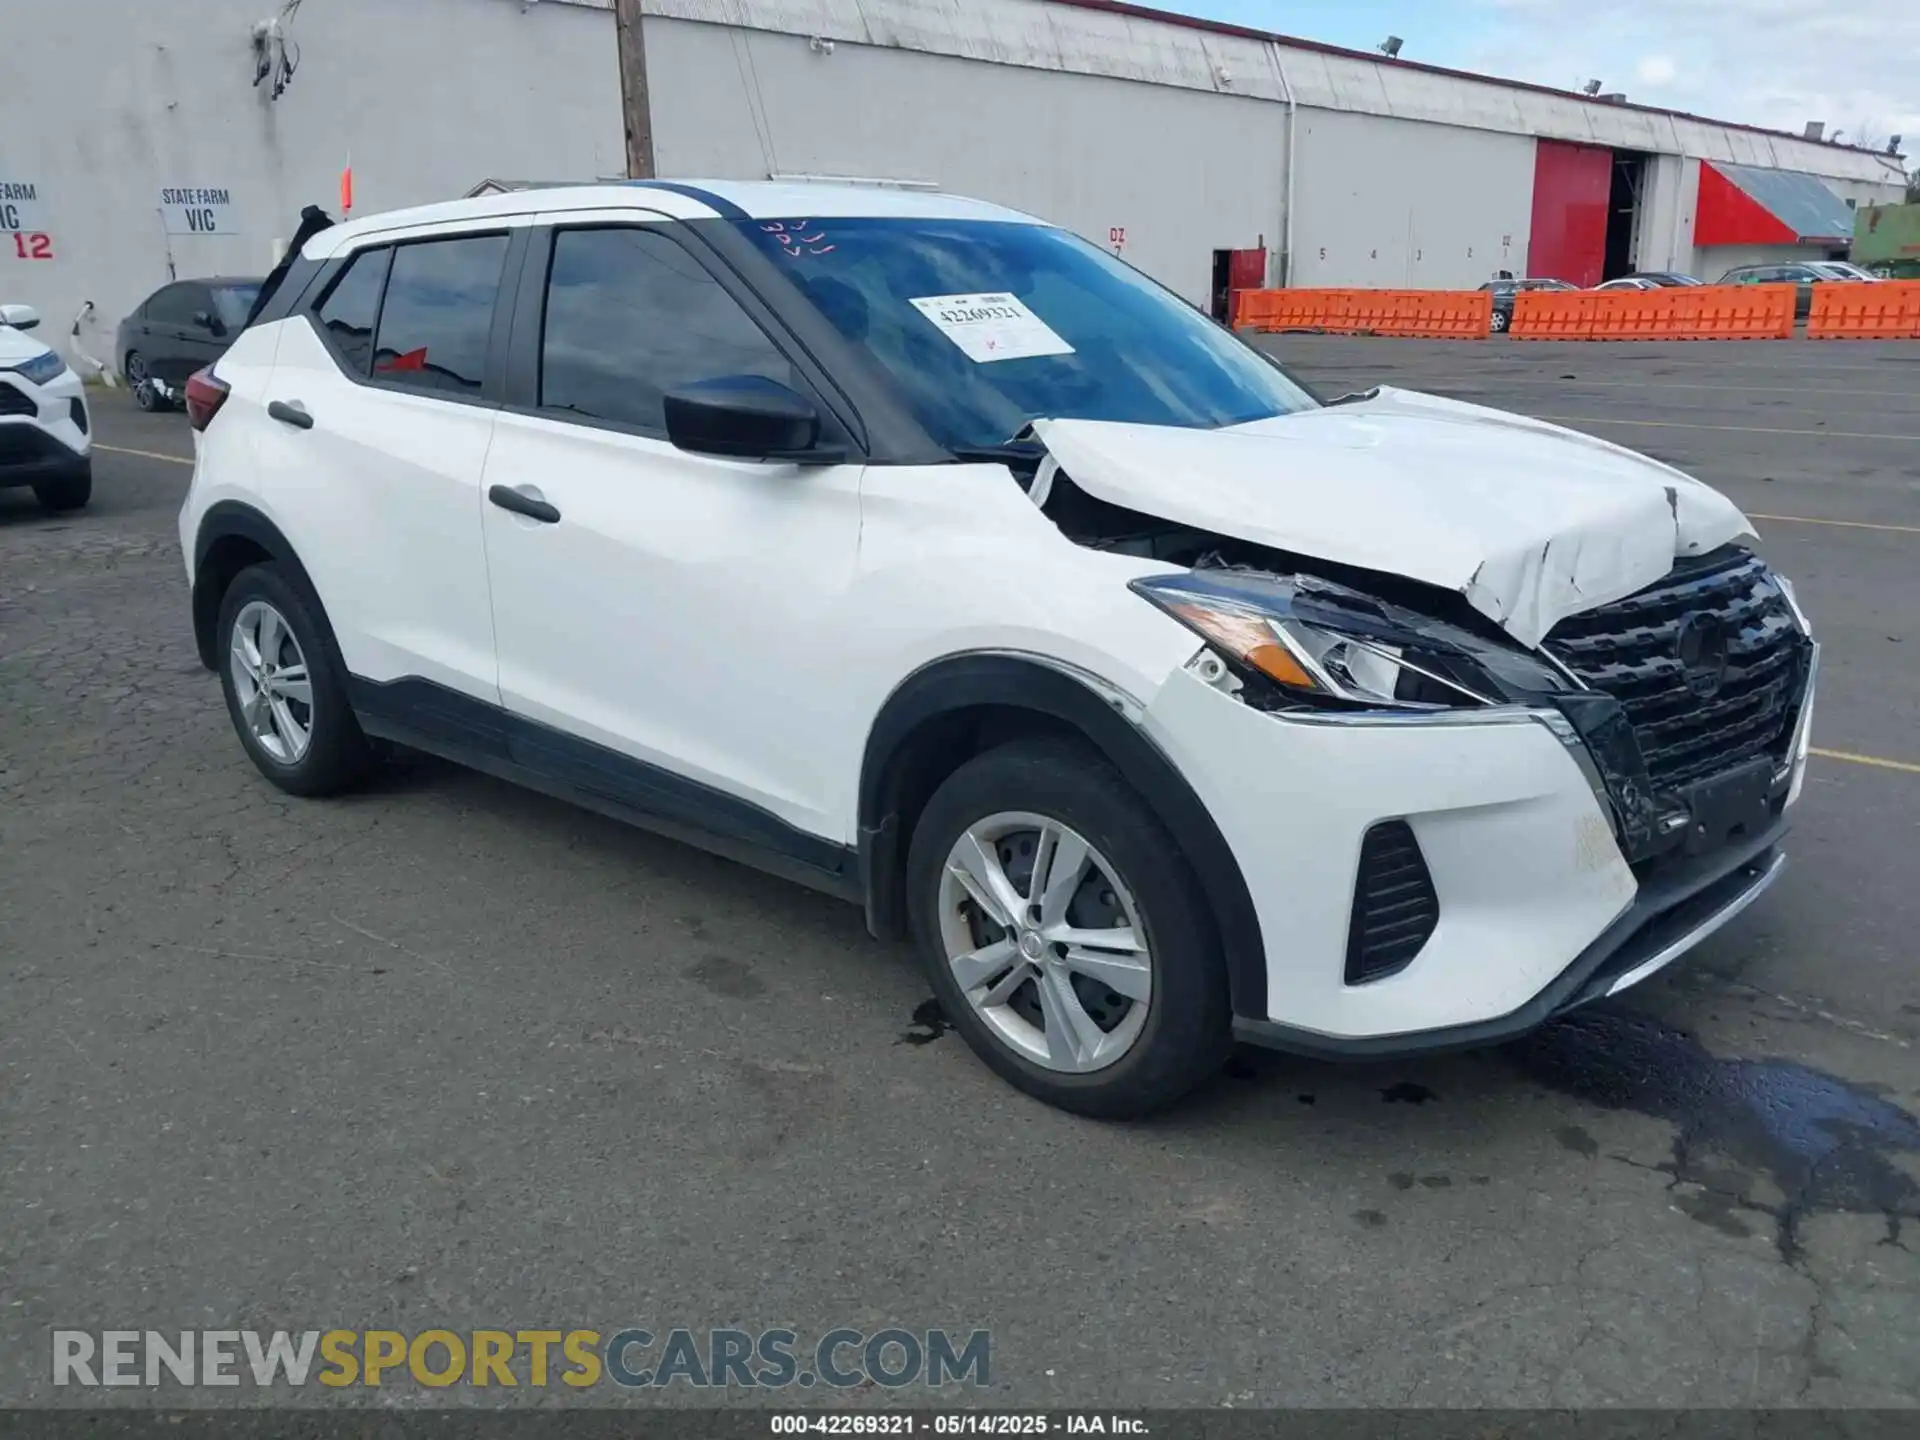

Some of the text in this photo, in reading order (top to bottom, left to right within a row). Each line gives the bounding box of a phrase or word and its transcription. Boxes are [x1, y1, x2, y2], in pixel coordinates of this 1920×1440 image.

[162, 188, 230, 205] STATE FARM
[185, 208, 215, 231] VIC
[13, 232, 53, 258] 12
[1320, 247, 1326, 260] 5
[940, 306, 1022, 322] 42269321
